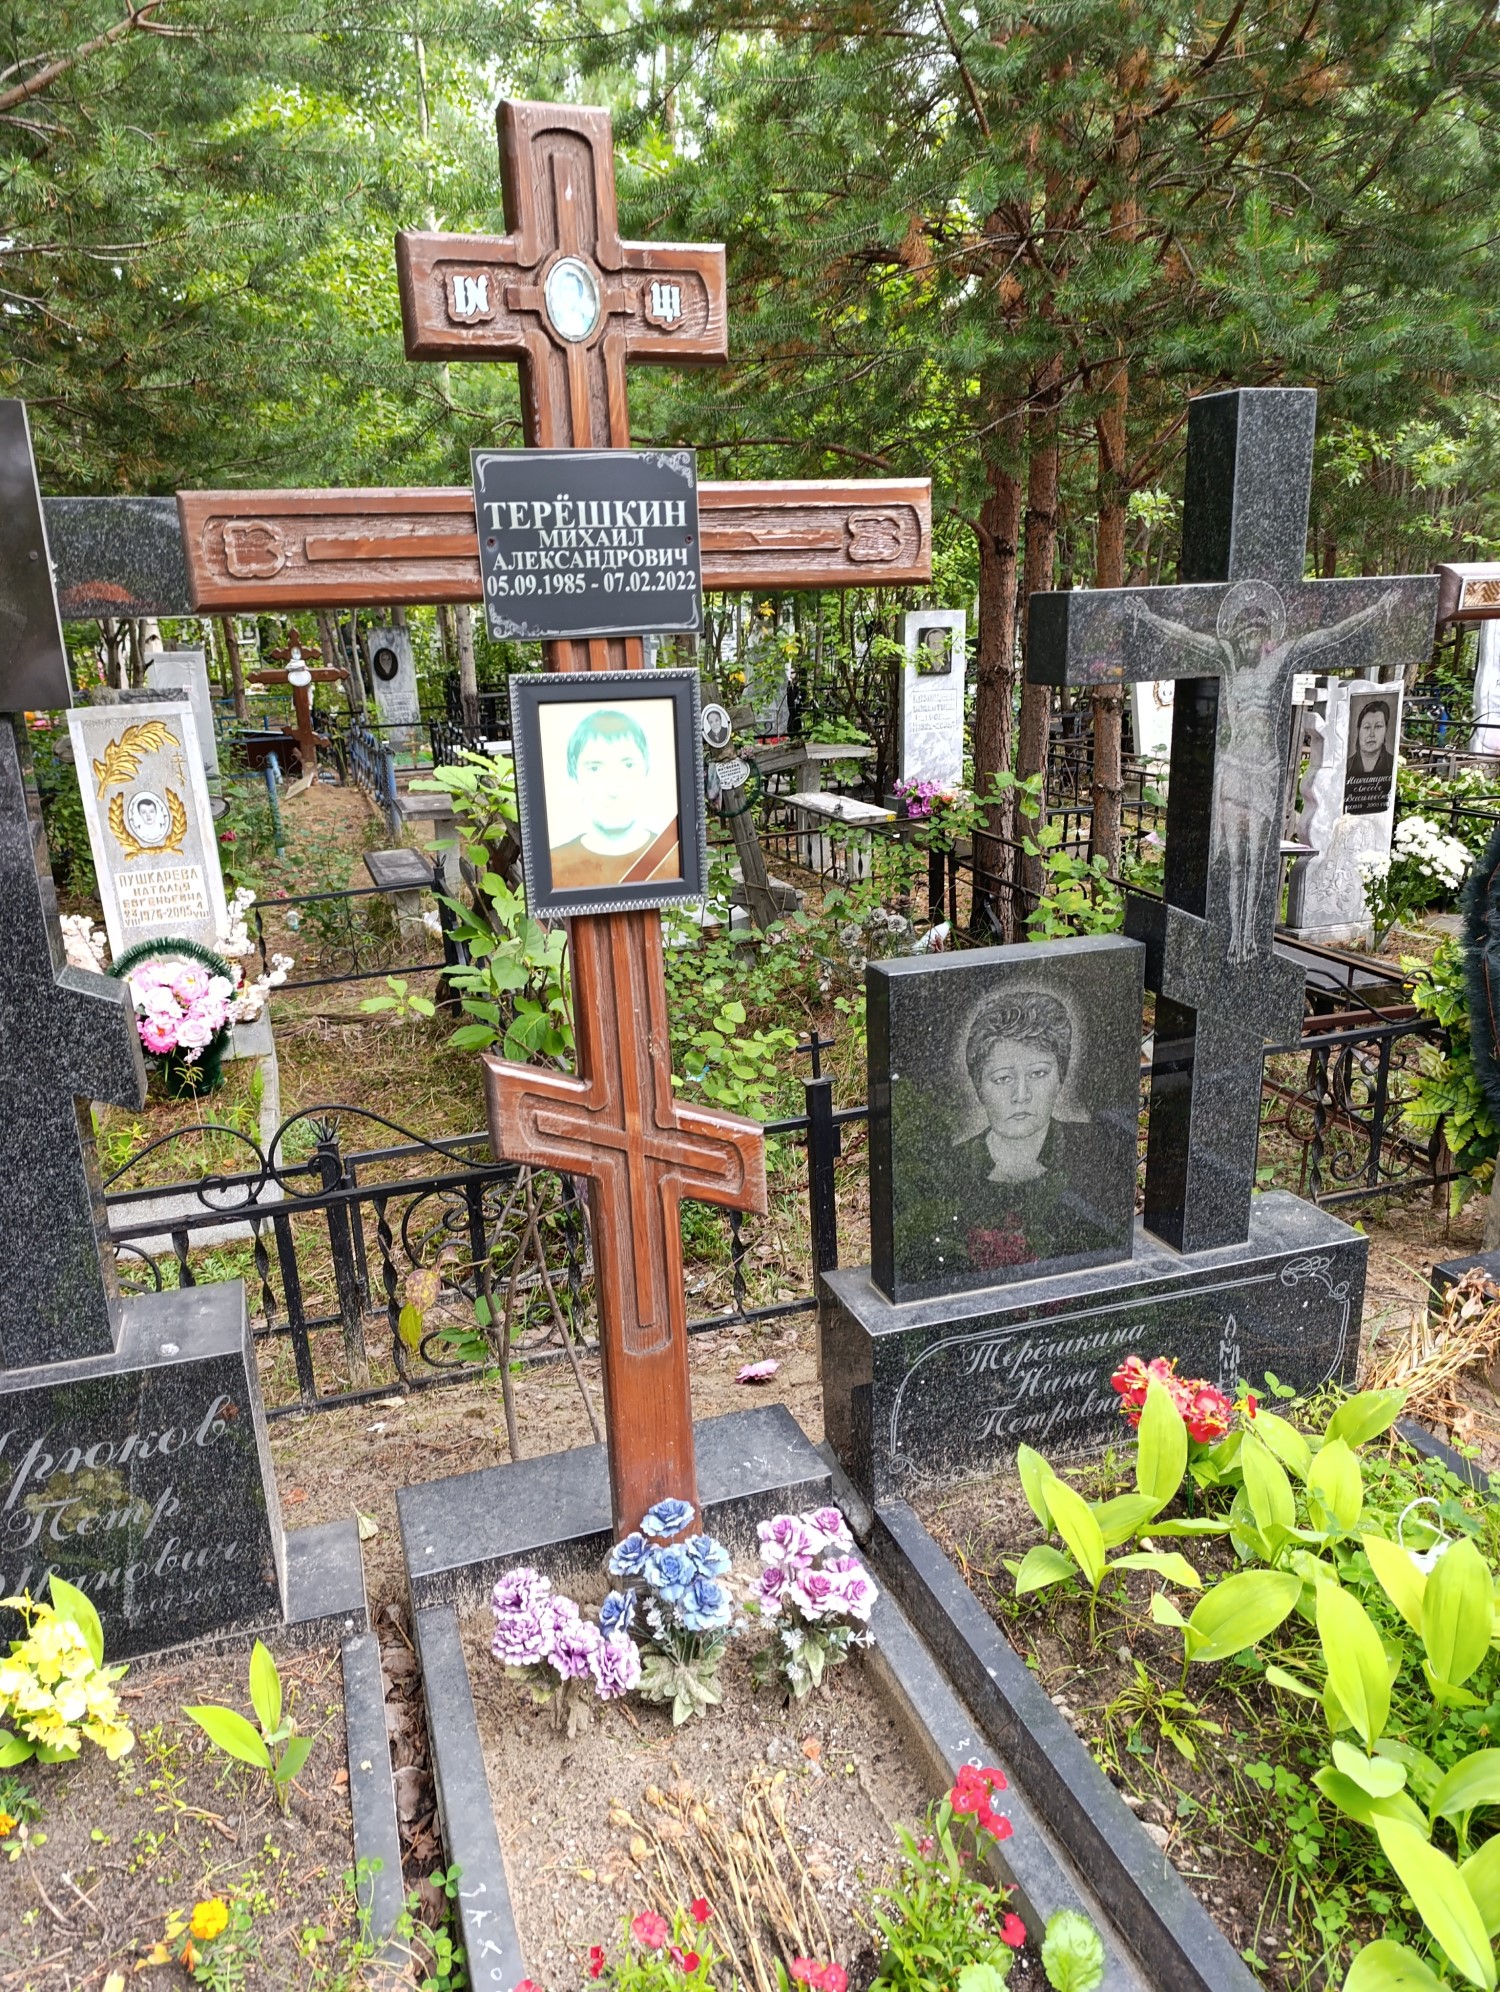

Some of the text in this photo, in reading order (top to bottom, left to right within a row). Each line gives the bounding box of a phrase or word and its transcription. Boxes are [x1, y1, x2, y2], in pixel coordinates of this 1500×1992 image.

[484, 493, 688, 530] ТЕРЁШКИН
[539, 528, 644, 549] МИХАИЛ
[493, 548, 688, 571] АЛЕКСАНДРОВИЧ
[487, 573, 586, 597] 05.09.1985
[603, 570, 697, 593] 07.02.2022
[118, 868, 199, 887] ПУШКАРЕВА
[133, 882, 191, 897] НАТАЛЬЯ
[122, 892, 203, 908] ЕВГЕНЬЕВНА
[957, 1324, 1147, 1380] Терёшкина
[1014, 1364, 1097, 1401] Нина
[972, 1388, 1124, 1441] Петровна
